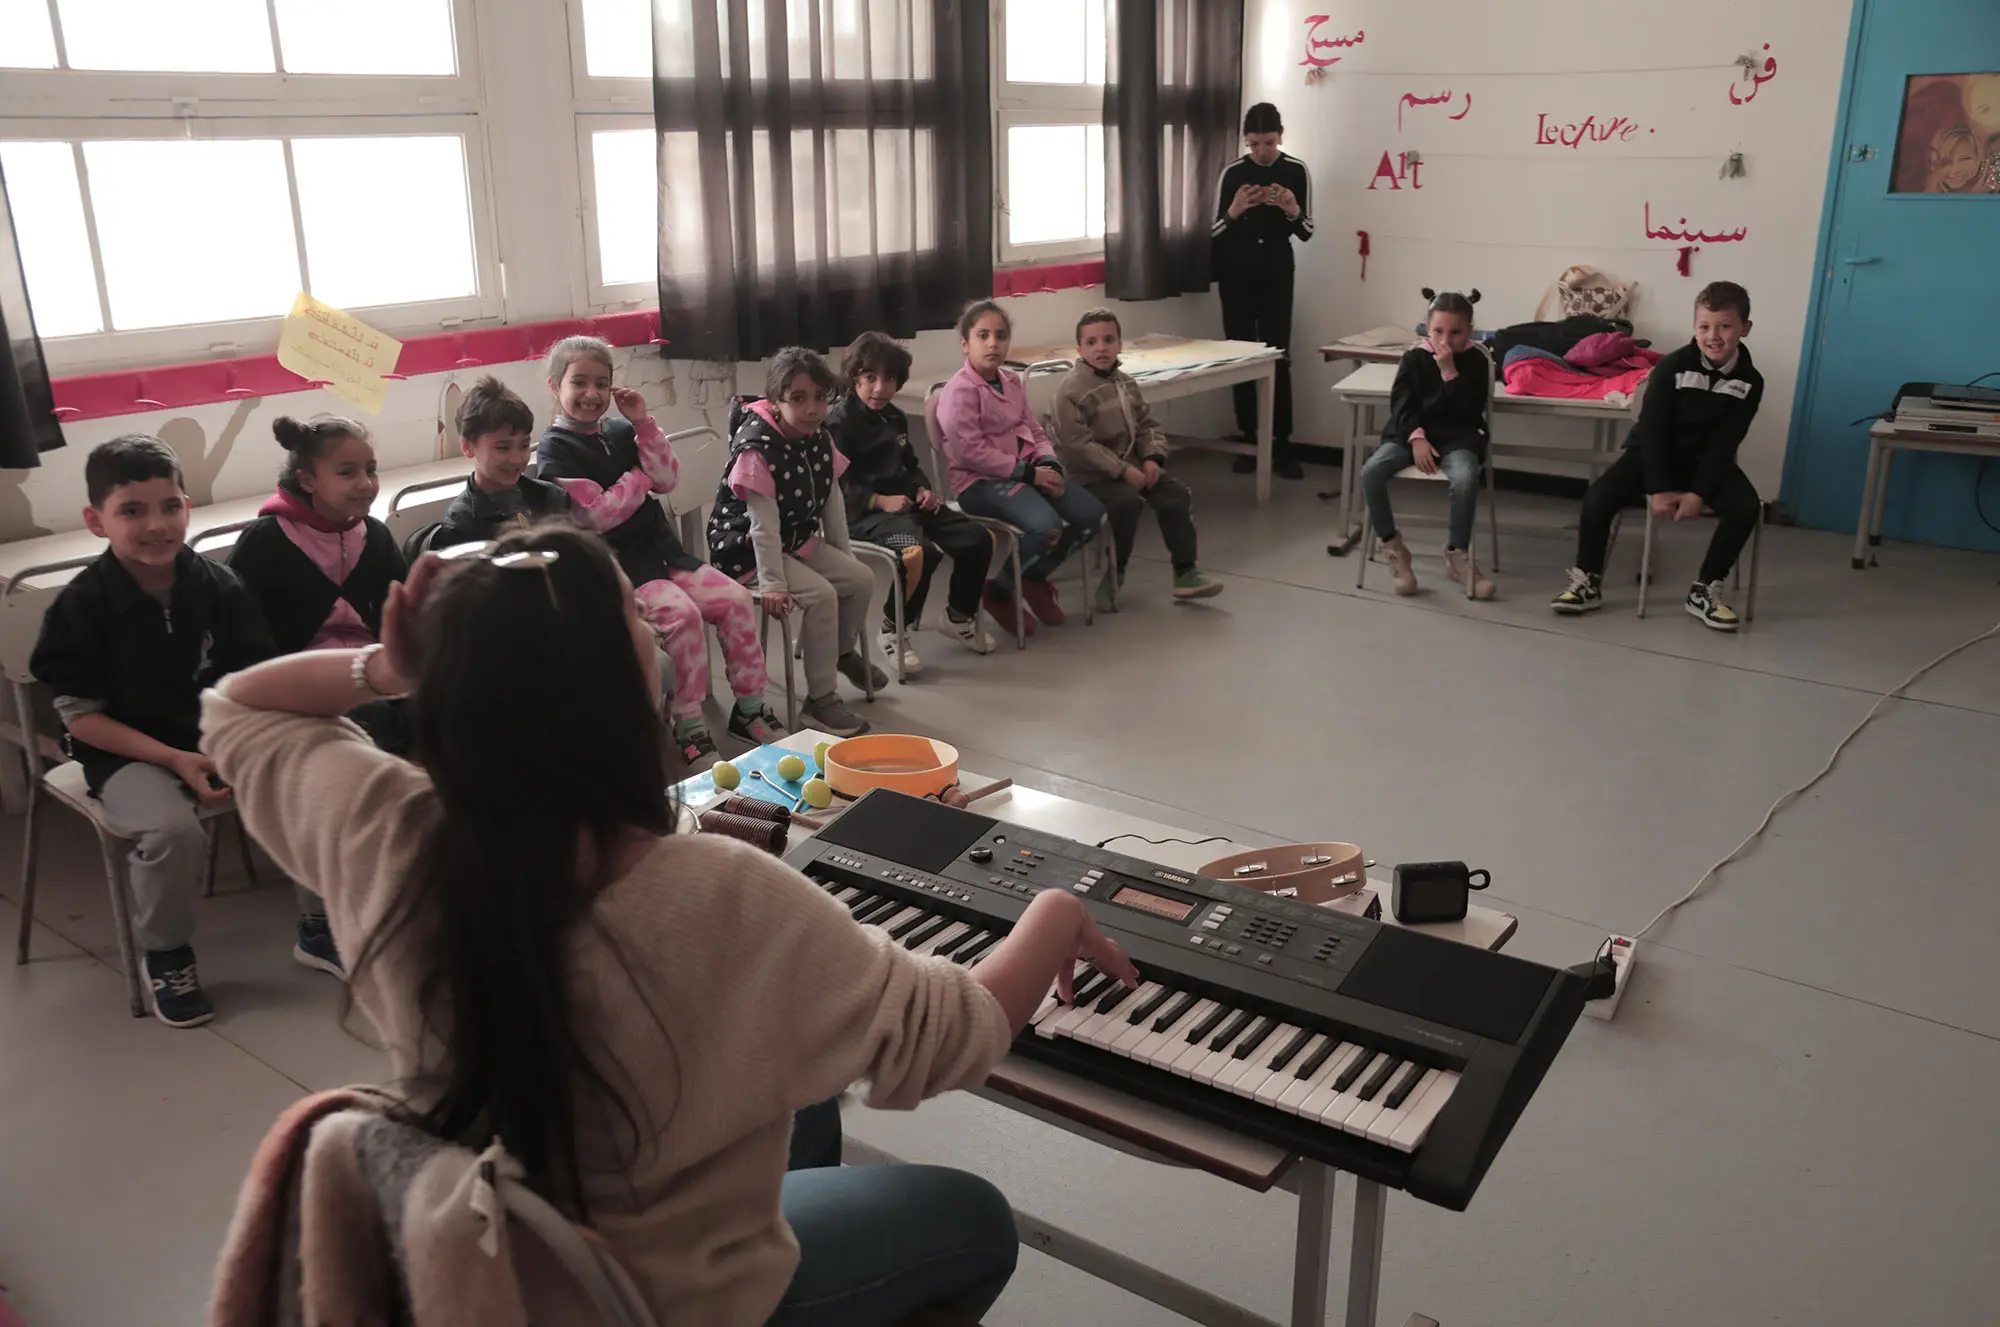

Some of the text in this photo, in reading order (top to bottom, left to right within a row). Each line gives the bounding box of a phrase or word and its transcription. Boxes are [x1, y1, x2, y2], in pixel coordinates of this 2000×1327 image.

[1398, 88, 1471, 134] رسم
[1644, 199, 1747, 252] سينما
[1162, 872, 1190, 884] YAMAHA
